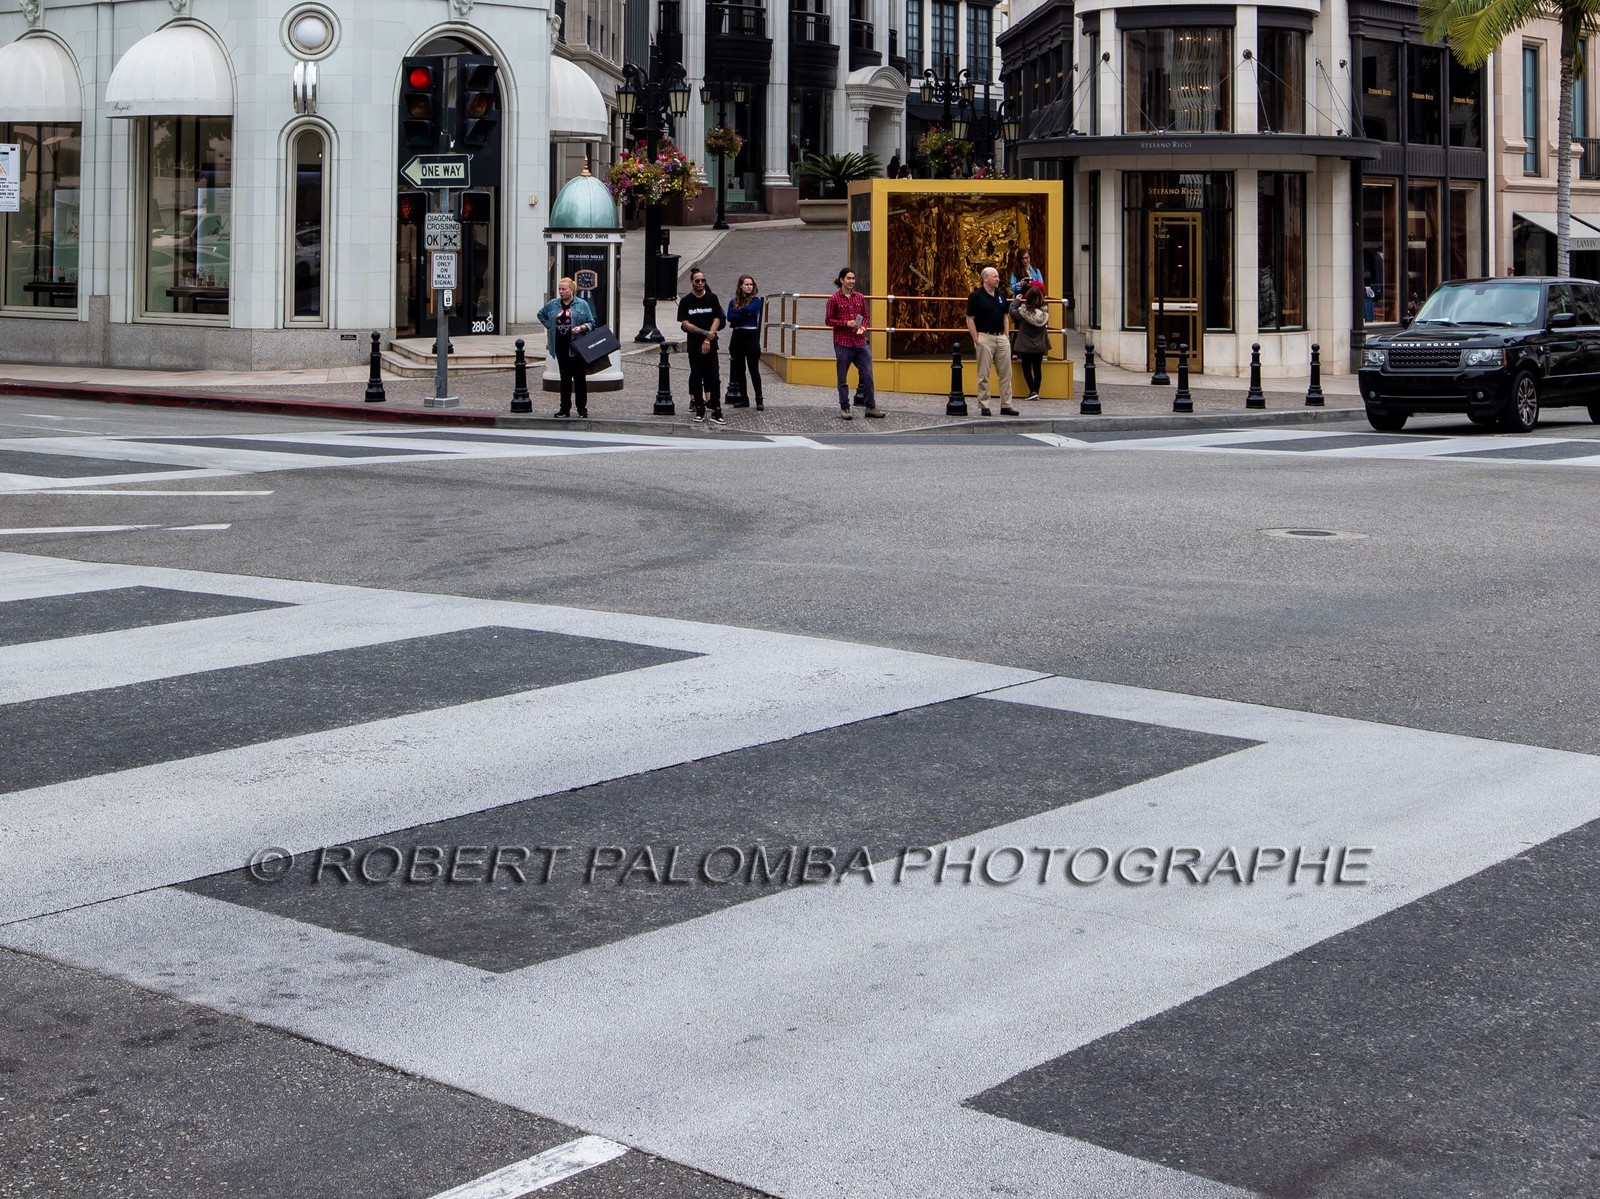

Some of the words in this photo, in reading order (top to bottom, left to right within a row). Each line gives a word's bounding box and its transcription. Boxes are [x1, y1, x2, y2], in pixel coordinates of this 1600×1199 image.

[421, 165, 440, 177] ONE
[442, 165, 462, 177] WAY
[427, 214, 455, 222] DIAGONA
[426, 234, 439, 246] OK
[472, 321, 486, 333] 280
